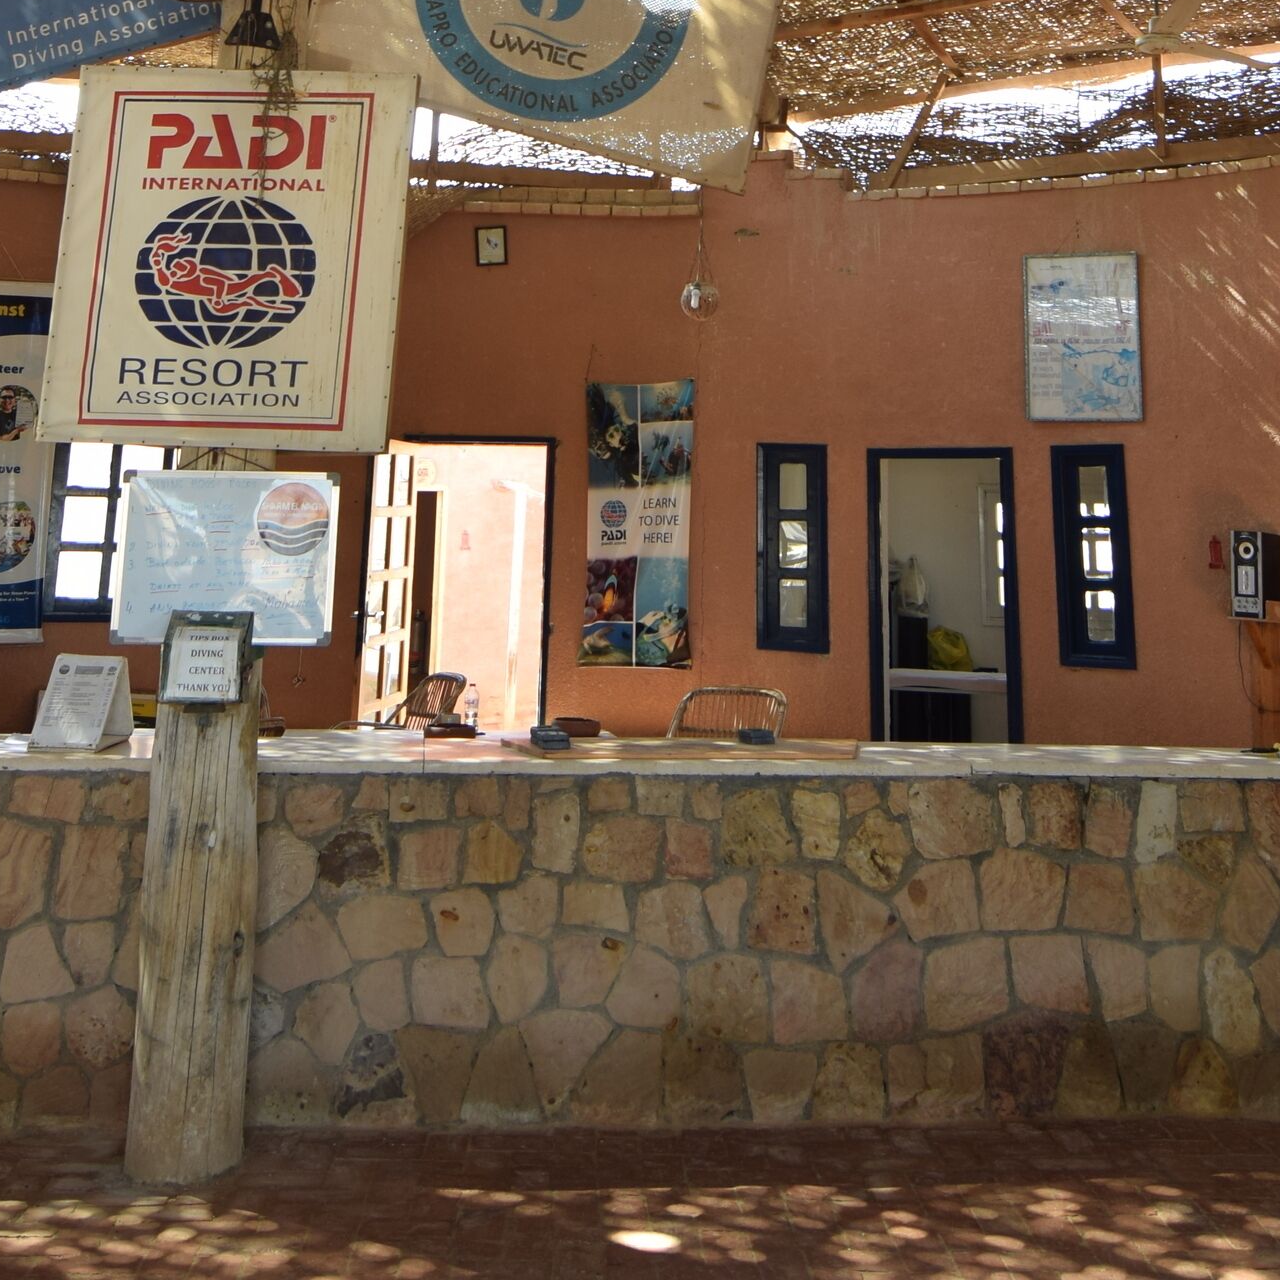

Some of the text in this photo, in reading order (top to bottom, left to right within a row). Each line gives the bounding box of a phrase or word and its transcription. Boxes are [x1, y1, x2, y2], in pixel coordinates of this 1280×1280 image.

[12, 39, 84, 70] Diving
[490, 29, 587, 71] UWATEC
[454, 52, 580, 113] EDUCATIONAL
[591, 18, 679, 108] ASSOCIATION
[147, 113, 327, 170] PADI
[142, 177, 325, 192] INTERNATIONAL
[119, 357, 308, 388] RESORT
[116, 391, 300, 408] ASSOCIATION
[643, 497, 677, 510] LEARN
[639, 515, 680, 527] TO DIVE
[601, 529, 627, 541] PADI
[644, 532, 673, 544] HERE!
[191, 649, 224, 658] DIVING
[189, 666, 225, 675] CENTER
[176, 683, 231, 693] THANK YOU
